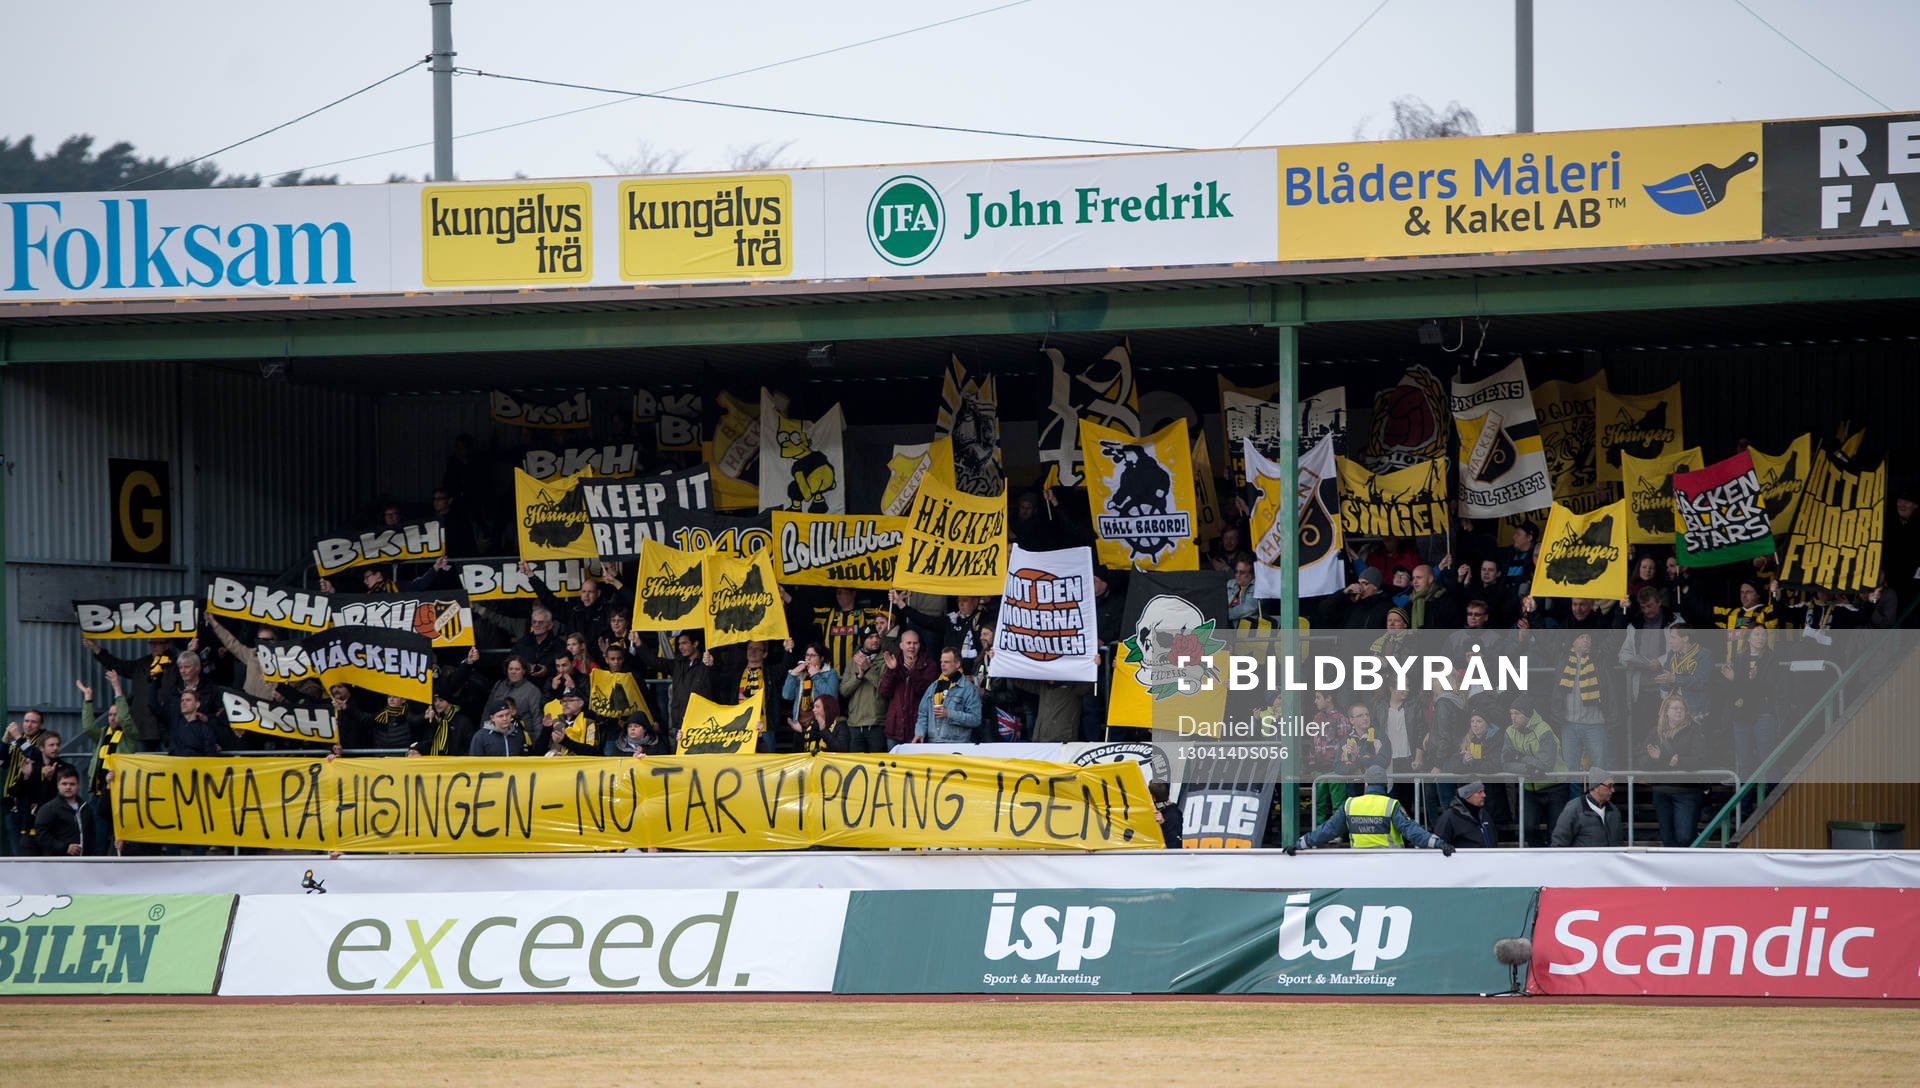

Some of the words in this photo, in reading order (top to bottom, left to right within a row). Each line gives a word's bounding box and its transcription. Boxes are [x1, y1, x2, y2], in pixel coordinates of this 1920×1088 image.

[1285, 161, 1458, 206] Blåders
[1474, 151, 1621, 197] Måleri
[431, 193, 582, 245] kungälvs
[629, 186, 781, 238] kungälvs
[876, 203, 937, 241] JFA
[964, 189, 1063, 240] John
[1076, 181, 1233, 225] Fredrik
[1404, 206, 1431, 237] &
[1445, 200, 1542, 235] Kakel
[1821, 183, 1910, 229] FA
[3, 199, 357, 292] Folksam
[536, 237, 582, 274] trä
[734, 230, 782, 267] trä
[494, 389, 588, 424] BKH
[636, 388, 702, 418] BK
[1452, 381, 1524, 412] INGENS
[1601, 422, 1675, 448] Hisingen
[525, 443, 635, 479] BKH
[1805, 448, 1885, 510] NITTON
[119, 470, 163, 553] G
[583, 482, 666, 519] KEEP
[676, 472, 710, 510] IT
[1632, 490, 1675, 513] Hisin
[1682, 494, 1763, 531] BLACK
[913, 495, 1004, 543] HÄCKEN
[1103, 518, 1132, 535] HÅLL
[1135, 518, 1185, 534] BABORD!
[1341, 499, 1450, 536] SINGEN
[1793, 492, 1884, 548] HUNDRA
[317, 520, 441, 570] BKH
[673, 526, 774, 560] 1940
[781, 521, 903, 575] Bollklubben
[905, 537, 1001, 578] VÄNNER
[1544, 541, 1620, 567] Hisingen
[463, 564, 582, 595] BKH
[1780, 533, 1883, 591] FYRTIO
[211, 577, 328, 627] BKH
[709, 588, 773, 615] Hisingen
[1036, 575, 1084, 604] DEN
[77, 600, 195, 633] BKH
[342, 600, 418, 631] BKH
[1003, 602, 1084, 631] MODERNA
[258, 644, 308, 678] BK
[1000, 629, 1086, 656] FOTBOLLEN
[311, 640, 428, 683] HÄCKEN!
[1151, 668, 1188, 681] FIDELIS
[222, 691, 333, 738] BKH
[681, 728, 752, 749] Hisingen
[1077, 745, 1153, 766] SREDUCERING
[119, 766, 270, 841] HEMMA
[281, 762, 326, 842] PÅ
[337, 770, 537, 840] HISINGEN
[576, 767, 638, 835] NU
[652, 764, 747, 835] TAR
[757, 766, 804, 832] VI
[819, 759, 968, 831] POÄNG
[993, 770, 1136, 843] IGEN!
[1350, 816, 1384, 825] ORDNINGS
[1358, 825, 1376, 833] VAKT
[327, 891, 750, 991] exceed.
[984, 892, 1116, 971] isp
[1278, 892, 1413, 971] isp
[1549, 906, 1875, 979] Scandic
[0, 925, 160, 983] BILEN
[983, 973, 1017, 986] Sport
[1021, 973, 1032, 984] &
[1035, 973, 1101, 987] Marketing
[1278, 973, 1312, 987] Sport
[1316, 973, 1326, 985] &
[1329, 973, 1396, 988] Marketing
